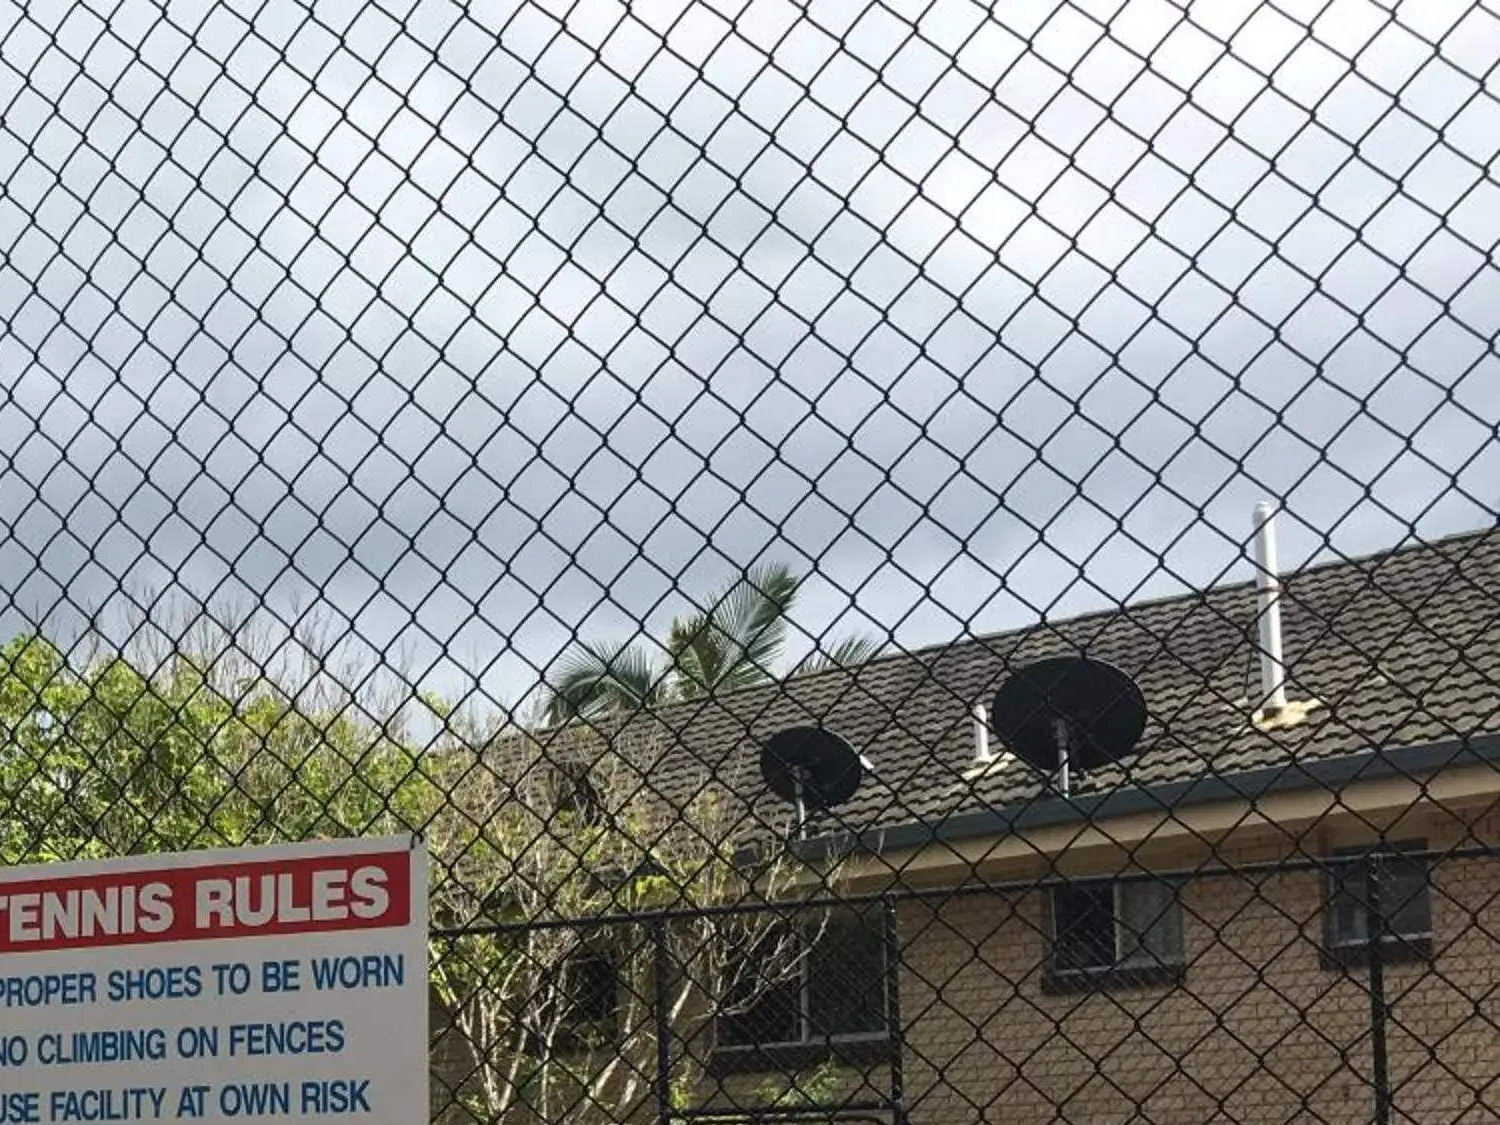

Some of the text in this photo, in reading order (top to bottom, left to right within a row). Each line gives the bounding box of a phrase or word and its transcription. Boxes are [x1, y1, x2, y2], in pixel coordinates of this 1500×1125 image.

[195, 865, 389, 930] RULES
[107, 965, 201, 1001] SHOES
[212, 963, 250, 996] TO
[262, 959, 300, 993] BE
[311, 953, 404, 990] WORN
[37, 1027, 166, 1065] CLIMBING
[177, 1025, 218, 1058] ON
[229, 1019, 344, 1056] FENCES
[50, 1087, 166, 1121] FACILITY
[176, 1085, 210, 1118] AT
[220, 1083, 289, 1116] OWN
[301, 1079, 371, 1113] RISK
